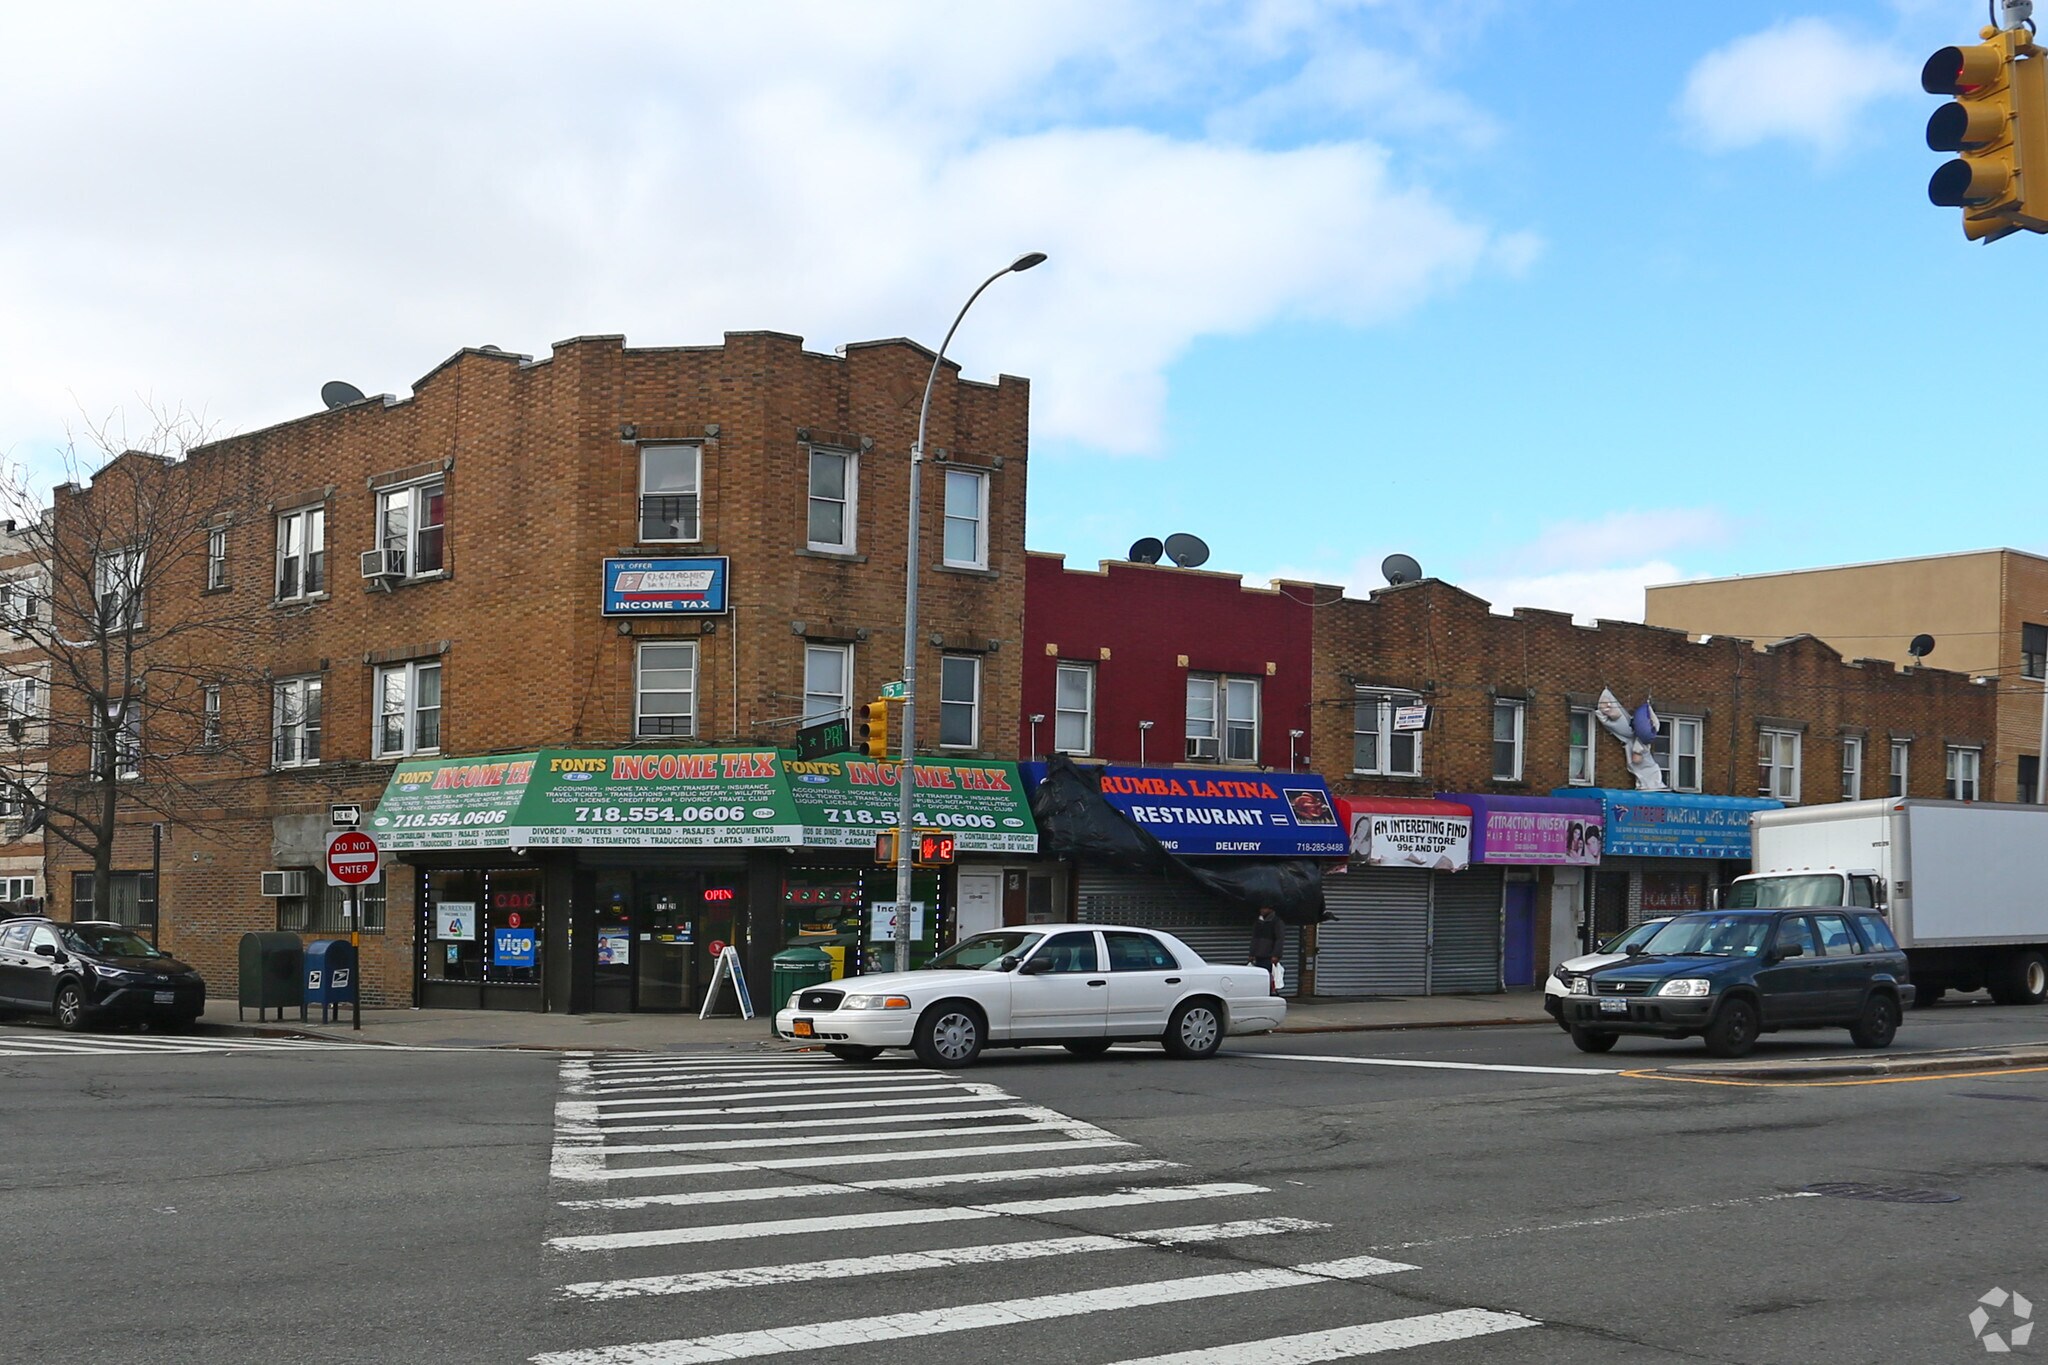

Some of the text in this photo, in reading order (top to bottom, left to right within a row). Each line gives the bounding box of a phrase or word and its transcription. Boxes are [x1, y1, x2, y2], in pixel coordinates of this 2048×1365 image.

[615, 601, 673, 609] INCOME
[550, 752, 776, 780] FONTS INCOME TAX
[395, 760, 537, 790] FONTS INCOME TA
[782, 760, 841, 776] FONTS
[954, 766, 1012, 792] TAX
[1101, 776, 1279, 799] RUMBA LATINA
[855, 795, 901, 803] TRANSLATIO
[392, 810, 508, 828] 718.554.0606
[575, 806, 745, 822] 718.554.0606
[823, 808, 996, 828] 718.54.0606
[1131, 806, 1264, 825] RESTAURANT
[1667, 808, 1702, 824] MARTIAL
[1704, 810, 1725, 826] ARTS
[1727, 810, 1750, 826] ACAD
[1374, 819, 1468, 838] AN INTERESTING FIND
[1487, 816, 1566, 830] ATTRACTION UNISEX
[485, 828, 510, 837] DOCUMENT
[623, 827, 672, 835] CONTABILIDAD
[682, 827, 716, 835] PASAJES
[849, 829, 876, 837] PASAJES
[964, 833, 1001, 841] CONTABILIDAD
[1008, 834, 1034, 842] DIVORCIO
[1487, 831, 1503, 841] HAIR
[1515, 831, 1539, 842] BEAUTY
[1543, 832, 1564, 842] SALON
[335, 841, 371, 851] DO NOT
[651, 836, 703, 844] TRADUCCIONES
[713, 836, 743, 844] CARTAS
[845, 838, 871, 846] CARGAS
[1017, 843, 1035, 851] VIAJES
[1386, 835, 1456, 845] VARIETY STORE
[940, 840, 952, 858] 12
[1216, 842, 1261, 851] DELIVERY
[1297, 843, 1344, 852] 718-285-9488
[1415, 844, 1431, 853] AND
[1434, 845, 1446, 853] UP
[339, 865, 368, 875] ENTER
[704, 889, 732, 900] OPEN
[497, 934, 532, 956] vigo
